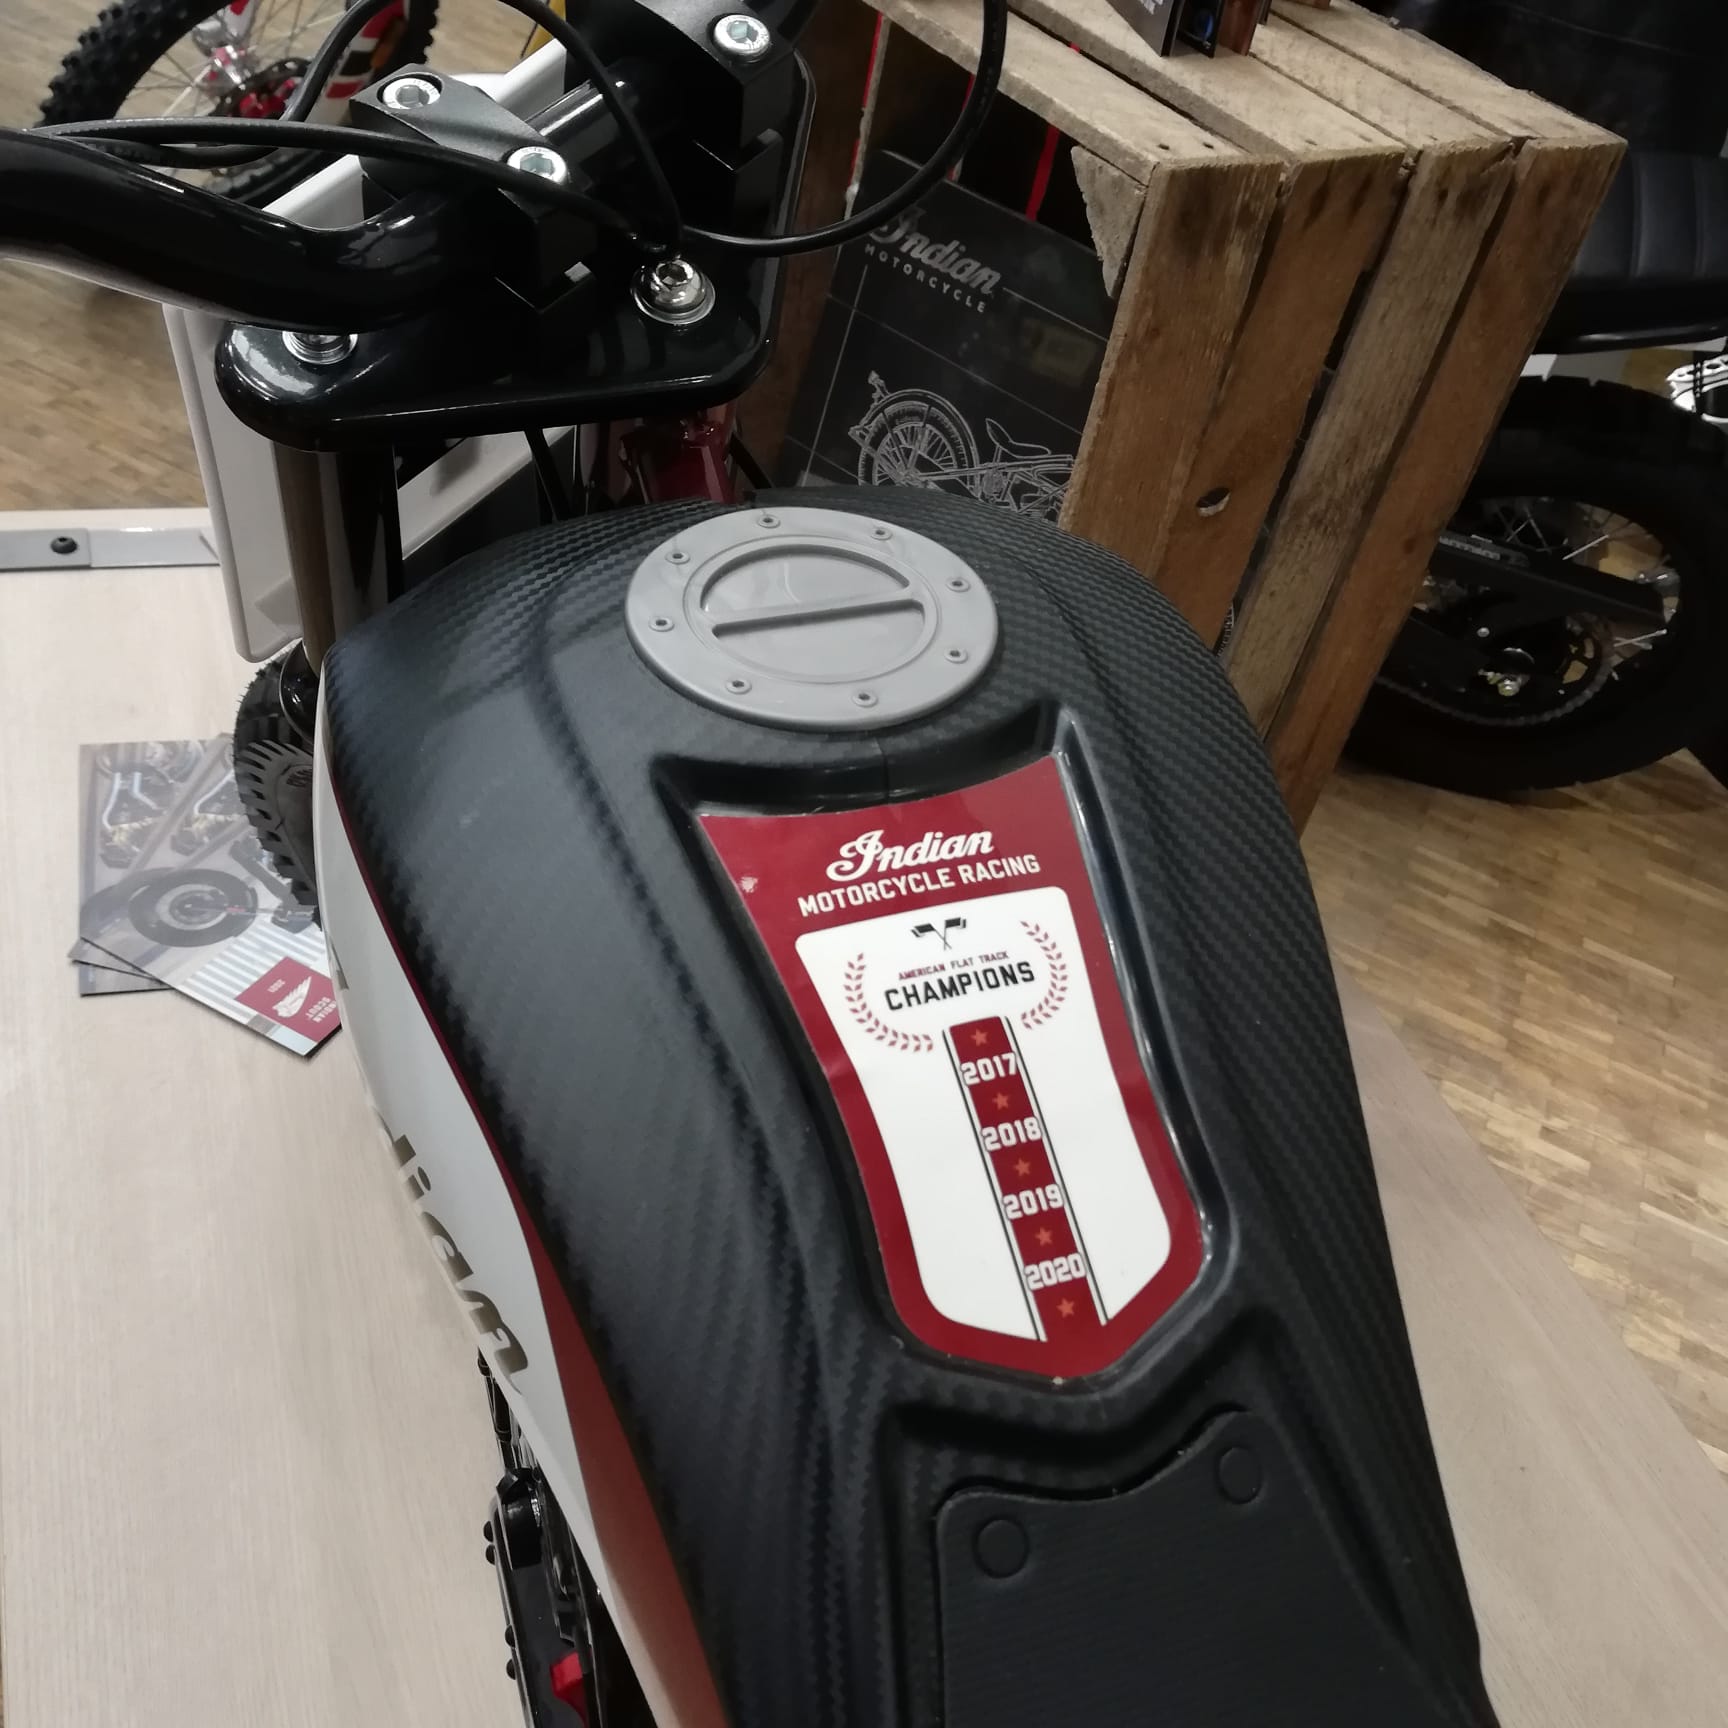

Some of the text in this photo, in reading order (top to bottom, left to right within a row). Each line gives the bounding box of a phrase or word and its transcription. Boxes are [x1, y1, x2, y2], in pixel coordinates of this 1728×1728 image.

[864, 243, 986, 313] MOTORCYCLE
[825, 829, 994, 882] Indian
[797, 854, 1041, 918] MOTORCYCLE RACING
[898, 950, 1009, 981] AMERICAN FLAT TRACK
[884, 961, 1036, 1012] CHAMPIONS
[960, 1052, 1018, 1086] 2017
[981, 1116, 1042, 1152] 2018
[1002, 1183, 1064, 1220] 2019
[1023, 1253, 1087, 1291] 2020
